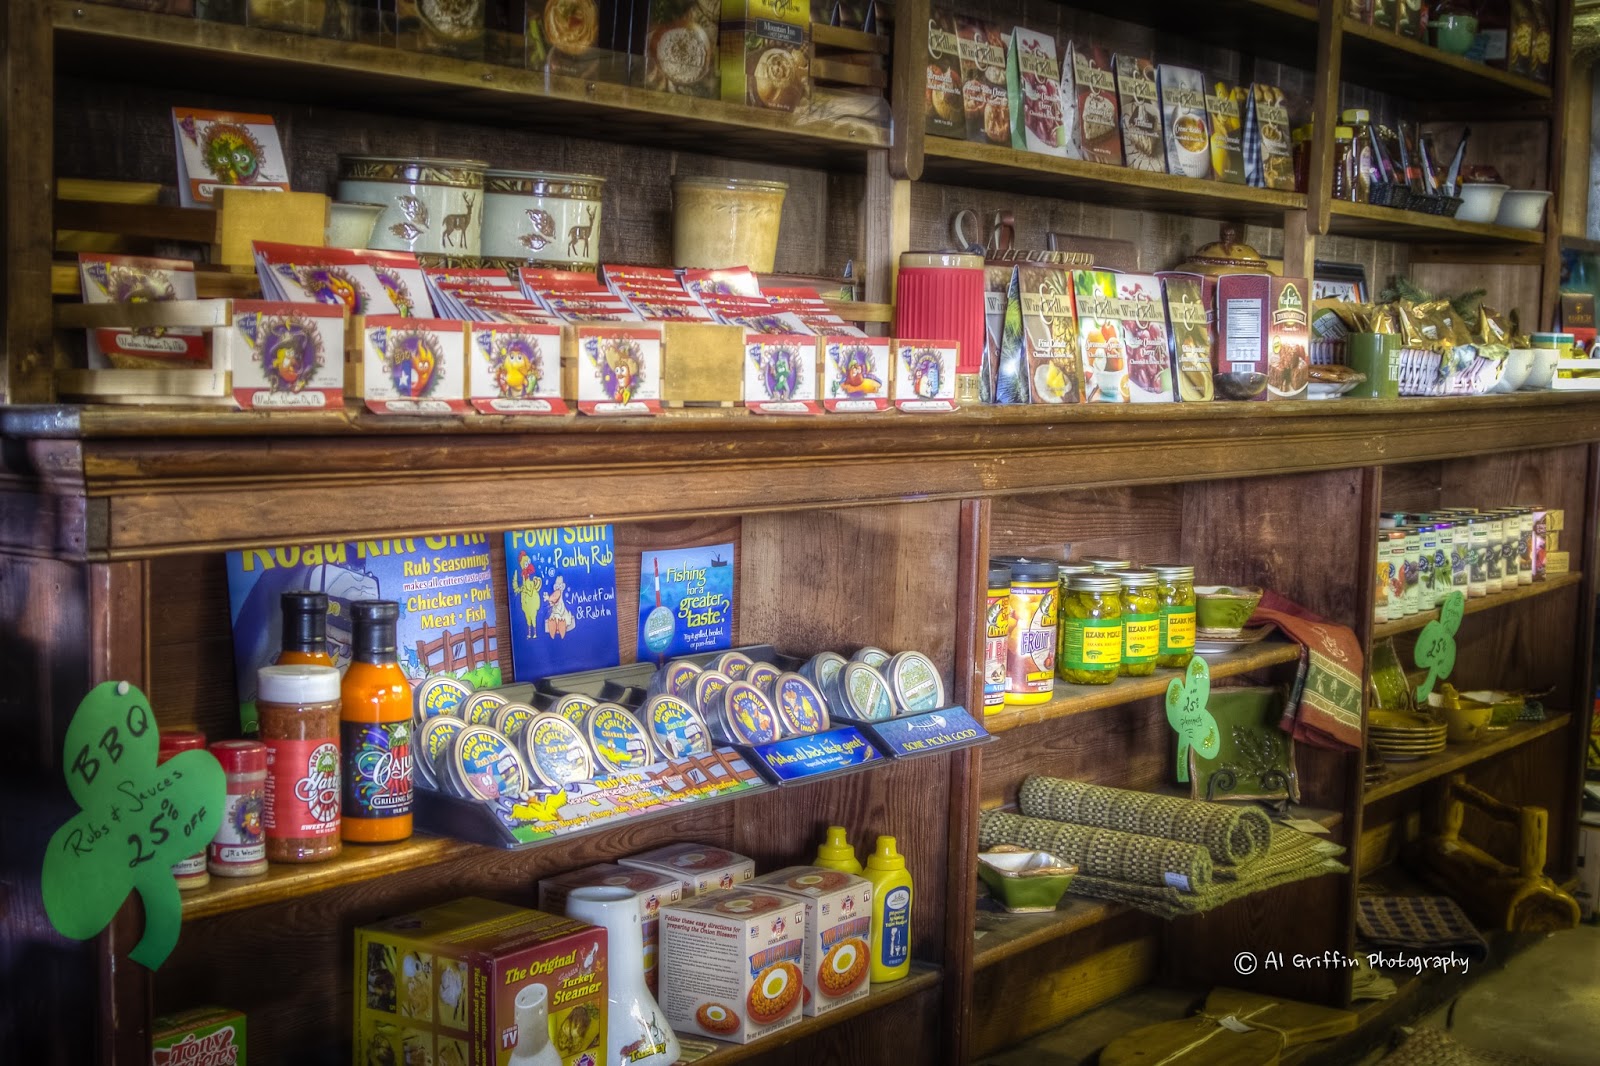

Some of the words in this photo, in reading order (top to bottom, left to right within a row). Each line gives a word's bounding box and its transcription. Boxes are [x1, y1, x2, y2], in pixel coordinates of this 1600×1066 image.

[763, 21, 787, 34] Mountain
[788, 26, 796, 35] Inn
[512, 527, 559, 549] Fowl
[241, 542, 347, 572] Road
[403, 557, 431, 577] Rub
[433, 551, 490, 573] Seasonings
[554, 546, 591, 574] Poultry
[591, 544, 613, 566] Rub
[403, 579, 428, 592] makes
[428, 576, 438, 588] all
[439, 575, 464, 587] critters
[464, 572, 479, 583] taste
[666, 560, 707, 587] Fishing
[407, 591, 462, 613] Chicken
[470, 584, 492, 603] Pork
[571, 590, 591, 604] Make
[598, 587, 615, 601] Fowl
[686, 581, 699, 595] for
[699, 586, 704, 594] a
[576, 606, 585, 620] &
[586, 604, 599, 620] Rub
[678, 592, 723, 618] greater
[687, 599, 731, 628] taste?
[421, 612, 457, 630] Meat
[465, 604, 486, 623] Fish
[427, 686, 442, 709] ROAD
[443, 684, 462, 698] KILL
[595, 710, 612, 729] ROAD
[614, 711, 632, 729] KILL
[654, 703, 668, 724] ROAD
[668, 701, 686, 715] KILL
[661, 709, 682, 724] GRILL
[603, 719, 626, 732] GRILL
[71, 705, 149, 785] BBQ
[463, 735, 478, 761] ROAD
[478, 733, 499, 747] KILL
[471, 743, 494, 759] GRILL
[766, 751, 798, 767] Makes
[842, 734, 865, 755] great
[903, 738, 927, 752] BONE
[926, 732, 952, 748] PICK'N
[951, 729, 977, 742] GOOD
[373, 796, 406, 806] GRILLING
[64, 824, 110, 858] Rubs
[117, 769, 183, 812] Sauces
[128, 798, 179, 869] 25%
[184, 806, 207, 838] OFF
[666, 922, 691, 933] preparing
[691, 925, 700, 933] the
[700, 927, 715, 936] Onion
[707, 922, 732, 932] directions
[732, 926, 741, 934] for
[505, 966, 528, 985] The
[529, 949, 577, 974] Original
[562, 972, 596, 989] Turkey
[553, 982, 602, 1006] Steamer
[171, 1025, 235, 1064] Tony
[502, 1029, 518, 1048] TV
